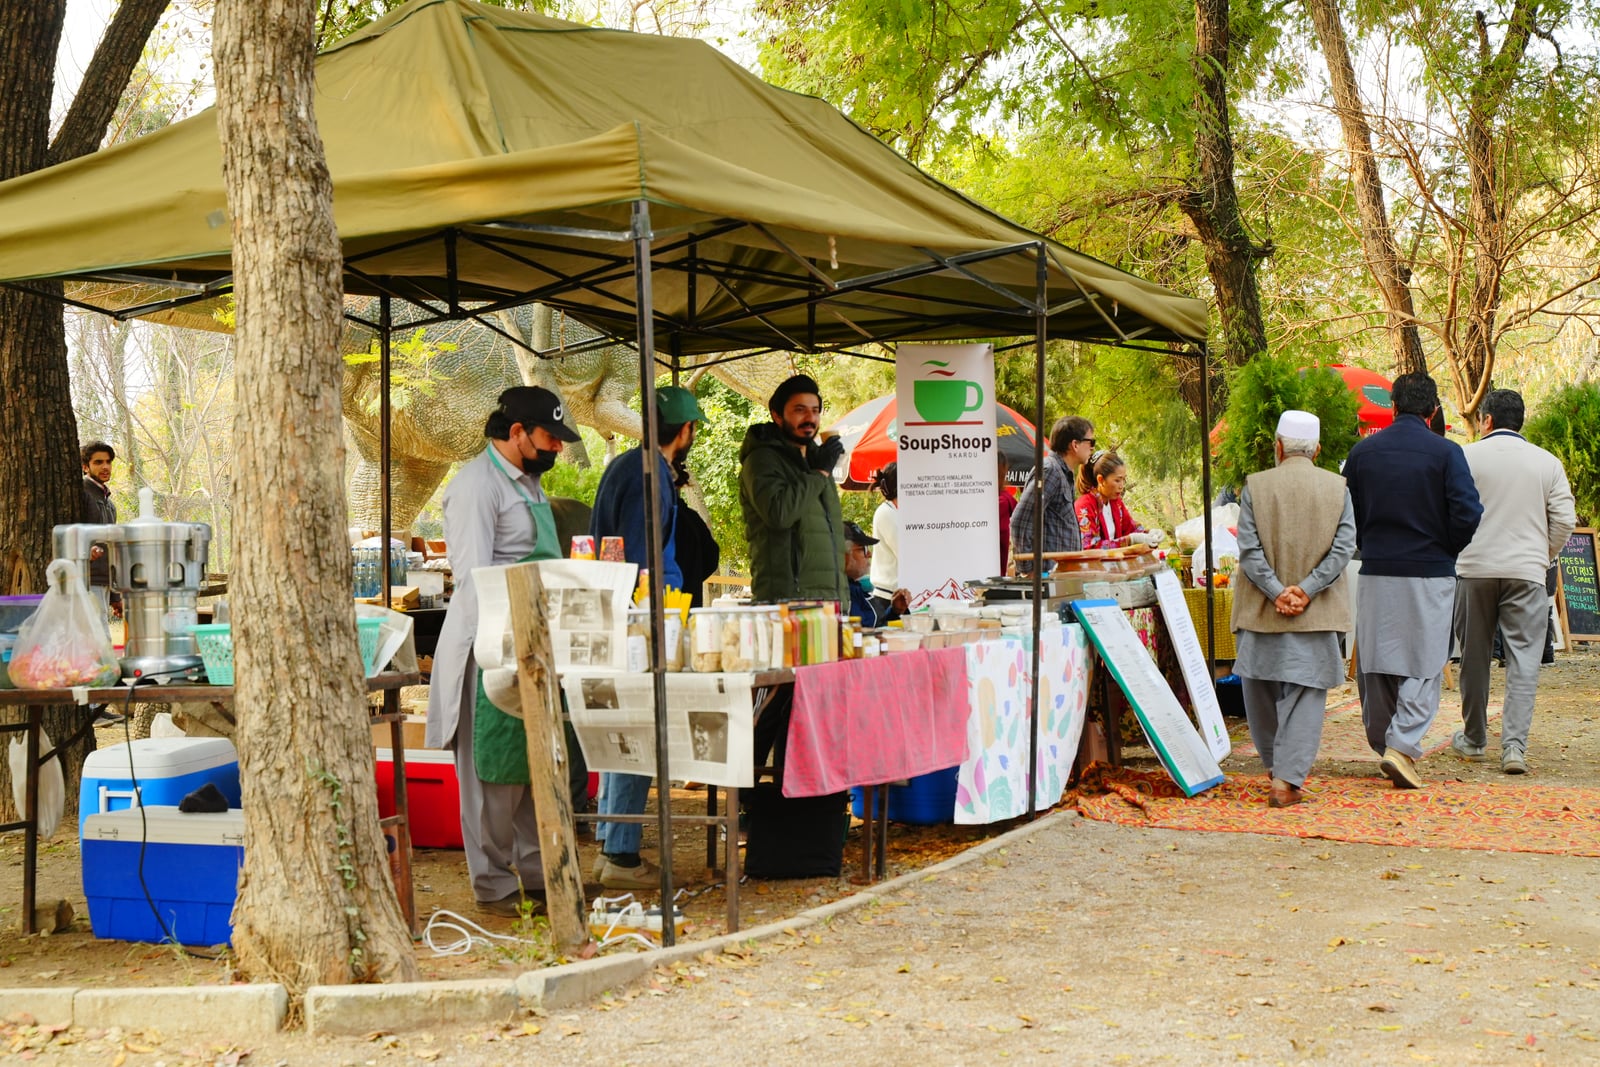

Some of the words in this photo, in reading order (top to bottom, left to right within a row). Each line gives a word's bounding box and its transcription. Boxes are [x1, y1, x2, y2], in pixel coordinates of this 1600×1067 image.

[899, 434, 992, 454] SoupShoop
[1004, 470, 1018, 482] HAI
[905, 520, 988, 531] www.soupshoop.com
[1565, 536, 1591, 547] ECIALS
[1560, 556, 1585, 565] FRESH
[1566, 565, 1594, 576] CITRUS
